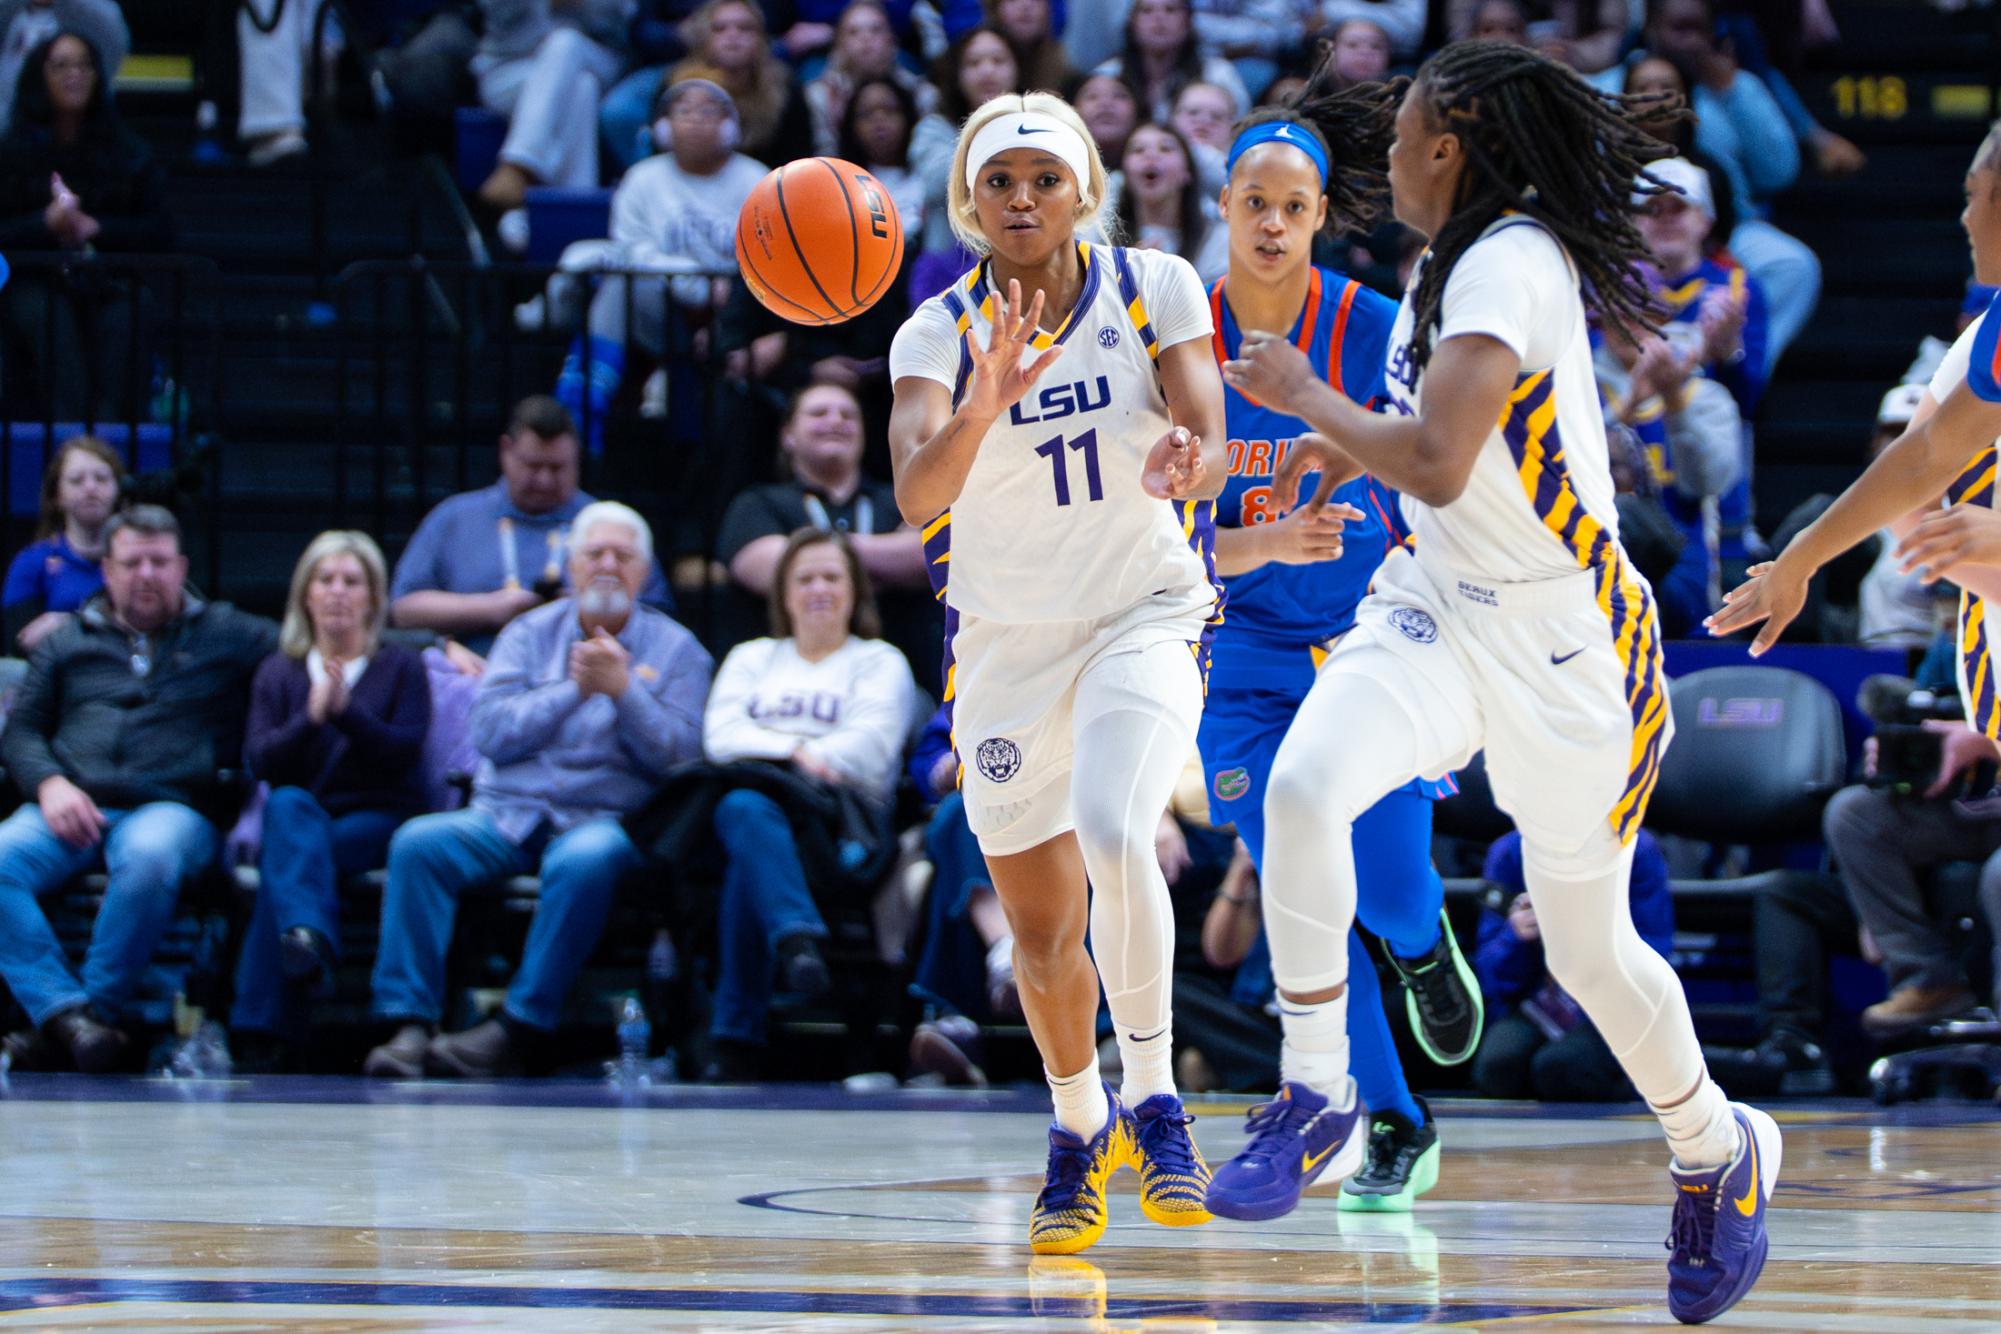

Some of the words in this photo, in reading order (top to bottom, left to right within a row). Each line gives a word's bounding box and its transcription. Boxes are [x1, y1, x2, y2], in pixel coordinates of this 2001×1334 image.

[855, 174, 888, 239] LSU
[1099, 327, 1118, 347] SEC
[1009, 375, 1112, 426] LSU
[1034, 427, 1104, 507] 11
[1241, 486, 1281, 527] 8
[746, 692, 839, 724] LSU
[1697, 697, 1784, 729] LSU
